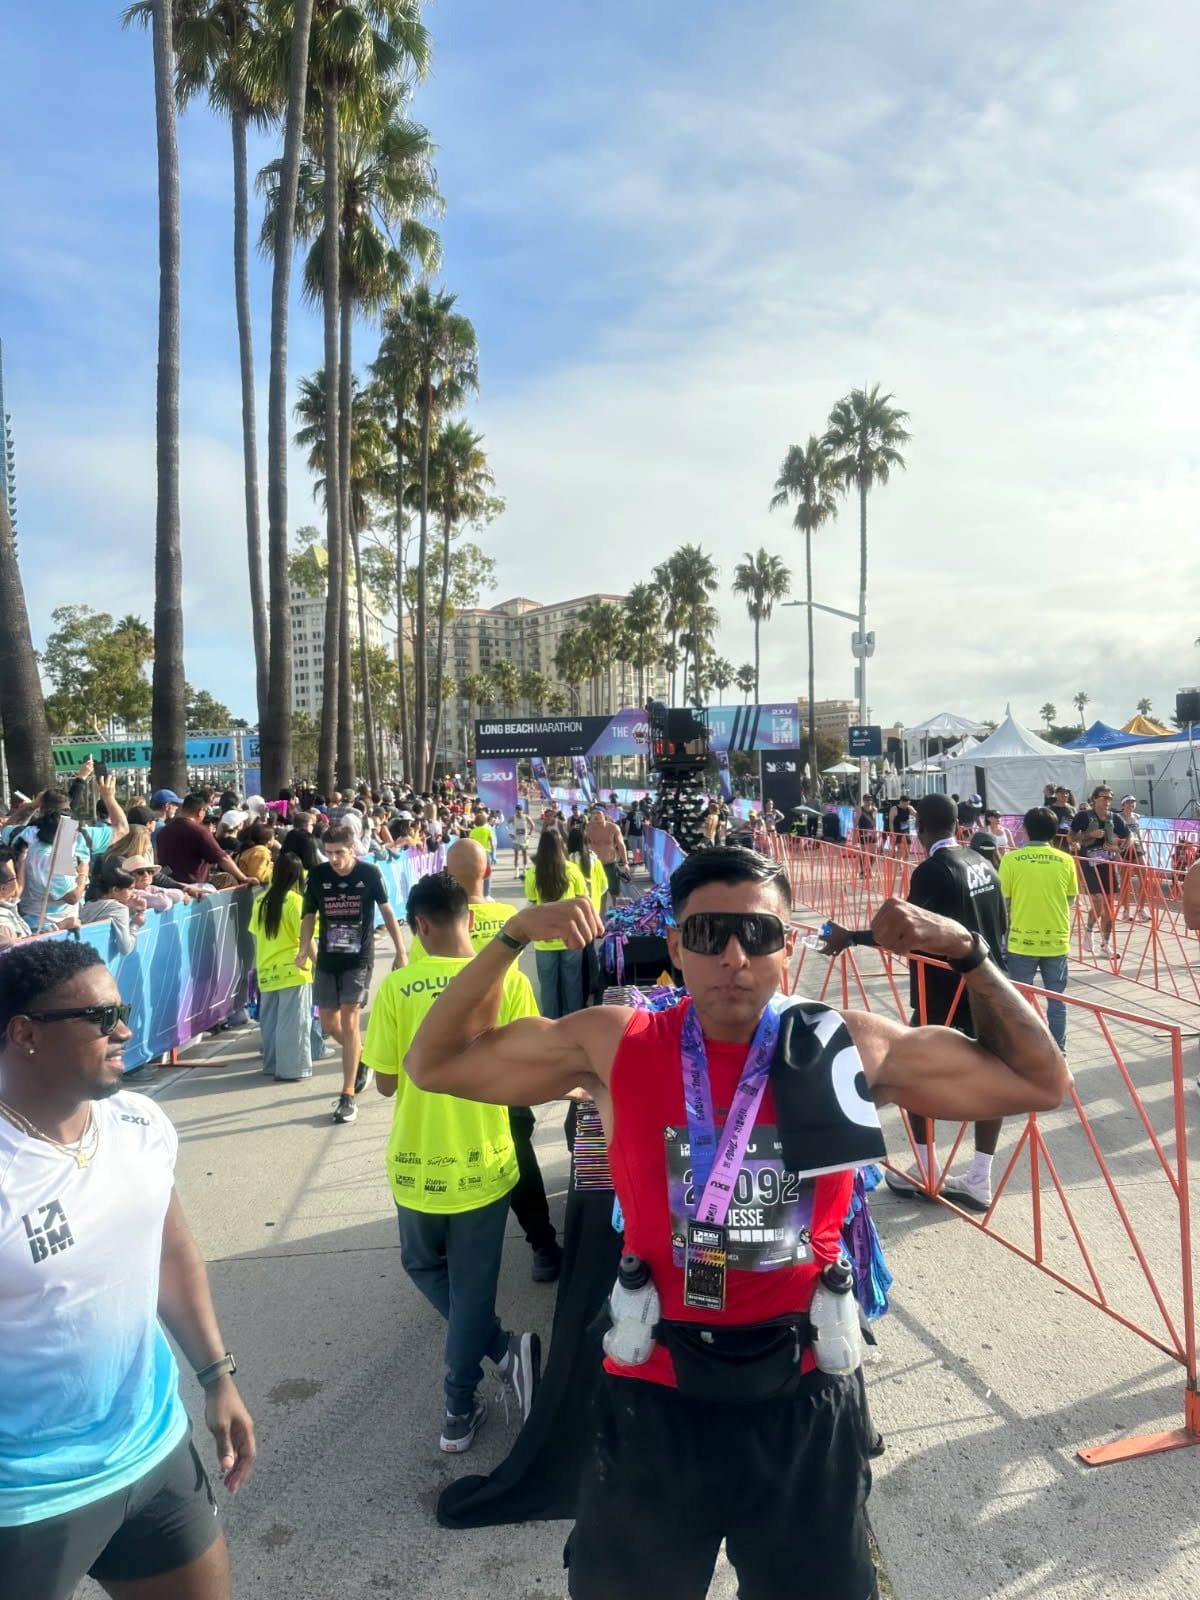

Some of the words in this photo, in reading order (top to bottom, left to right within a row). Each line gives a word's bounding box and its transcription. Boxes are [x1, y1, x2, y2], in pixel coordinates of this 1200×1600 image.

[479, 724, 503, 735] LONG
[504, 723, 534, 734] BEACH
[534, 721, 583, 734] MARATHON
[612, 726, 629, 737] THE
[101, 747, 136, 763] BIKE
[481, 772, 513, 782] 2XU
[400, 976, 448, 998] VOLU
[121, 1114, 150, 1127] 2XU
[683, 1167, 800, 1206] 2092
[727, 1208, 765, 1227] JESSE
